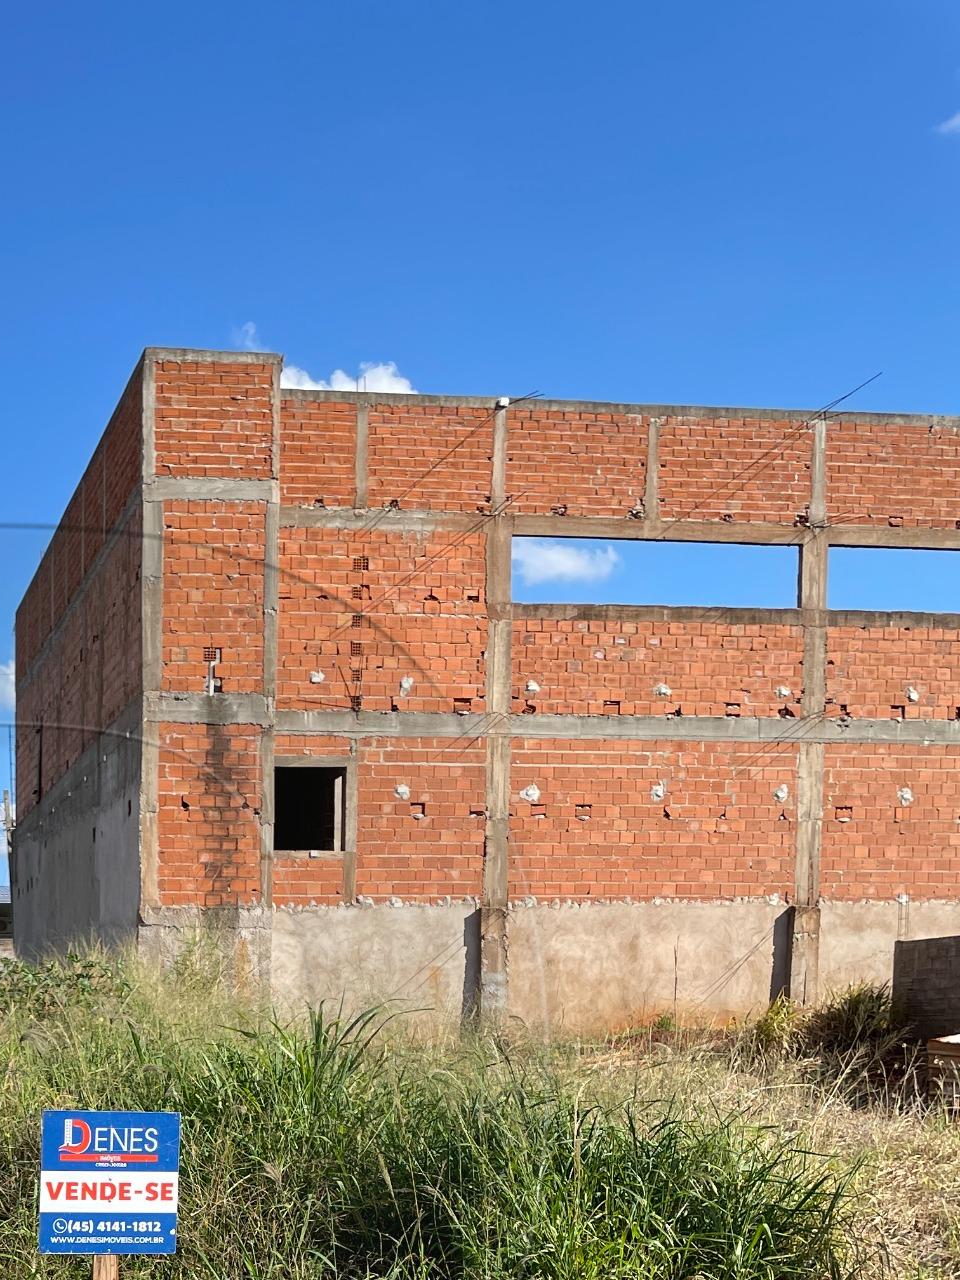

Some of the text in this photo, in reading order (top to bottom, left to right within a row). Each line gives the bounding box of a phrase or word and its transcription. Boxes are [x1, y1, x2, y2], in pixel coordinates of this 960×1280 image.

[58, 1118, 158, 1154] DENES
[45, 1181, 174, 1202] VENDE-SE
[67, 1219, 162, 1234] (45) 4141-1812
[50, 1235, 165, 1245] WWW.DENESIMOVEIS.COM.BR
